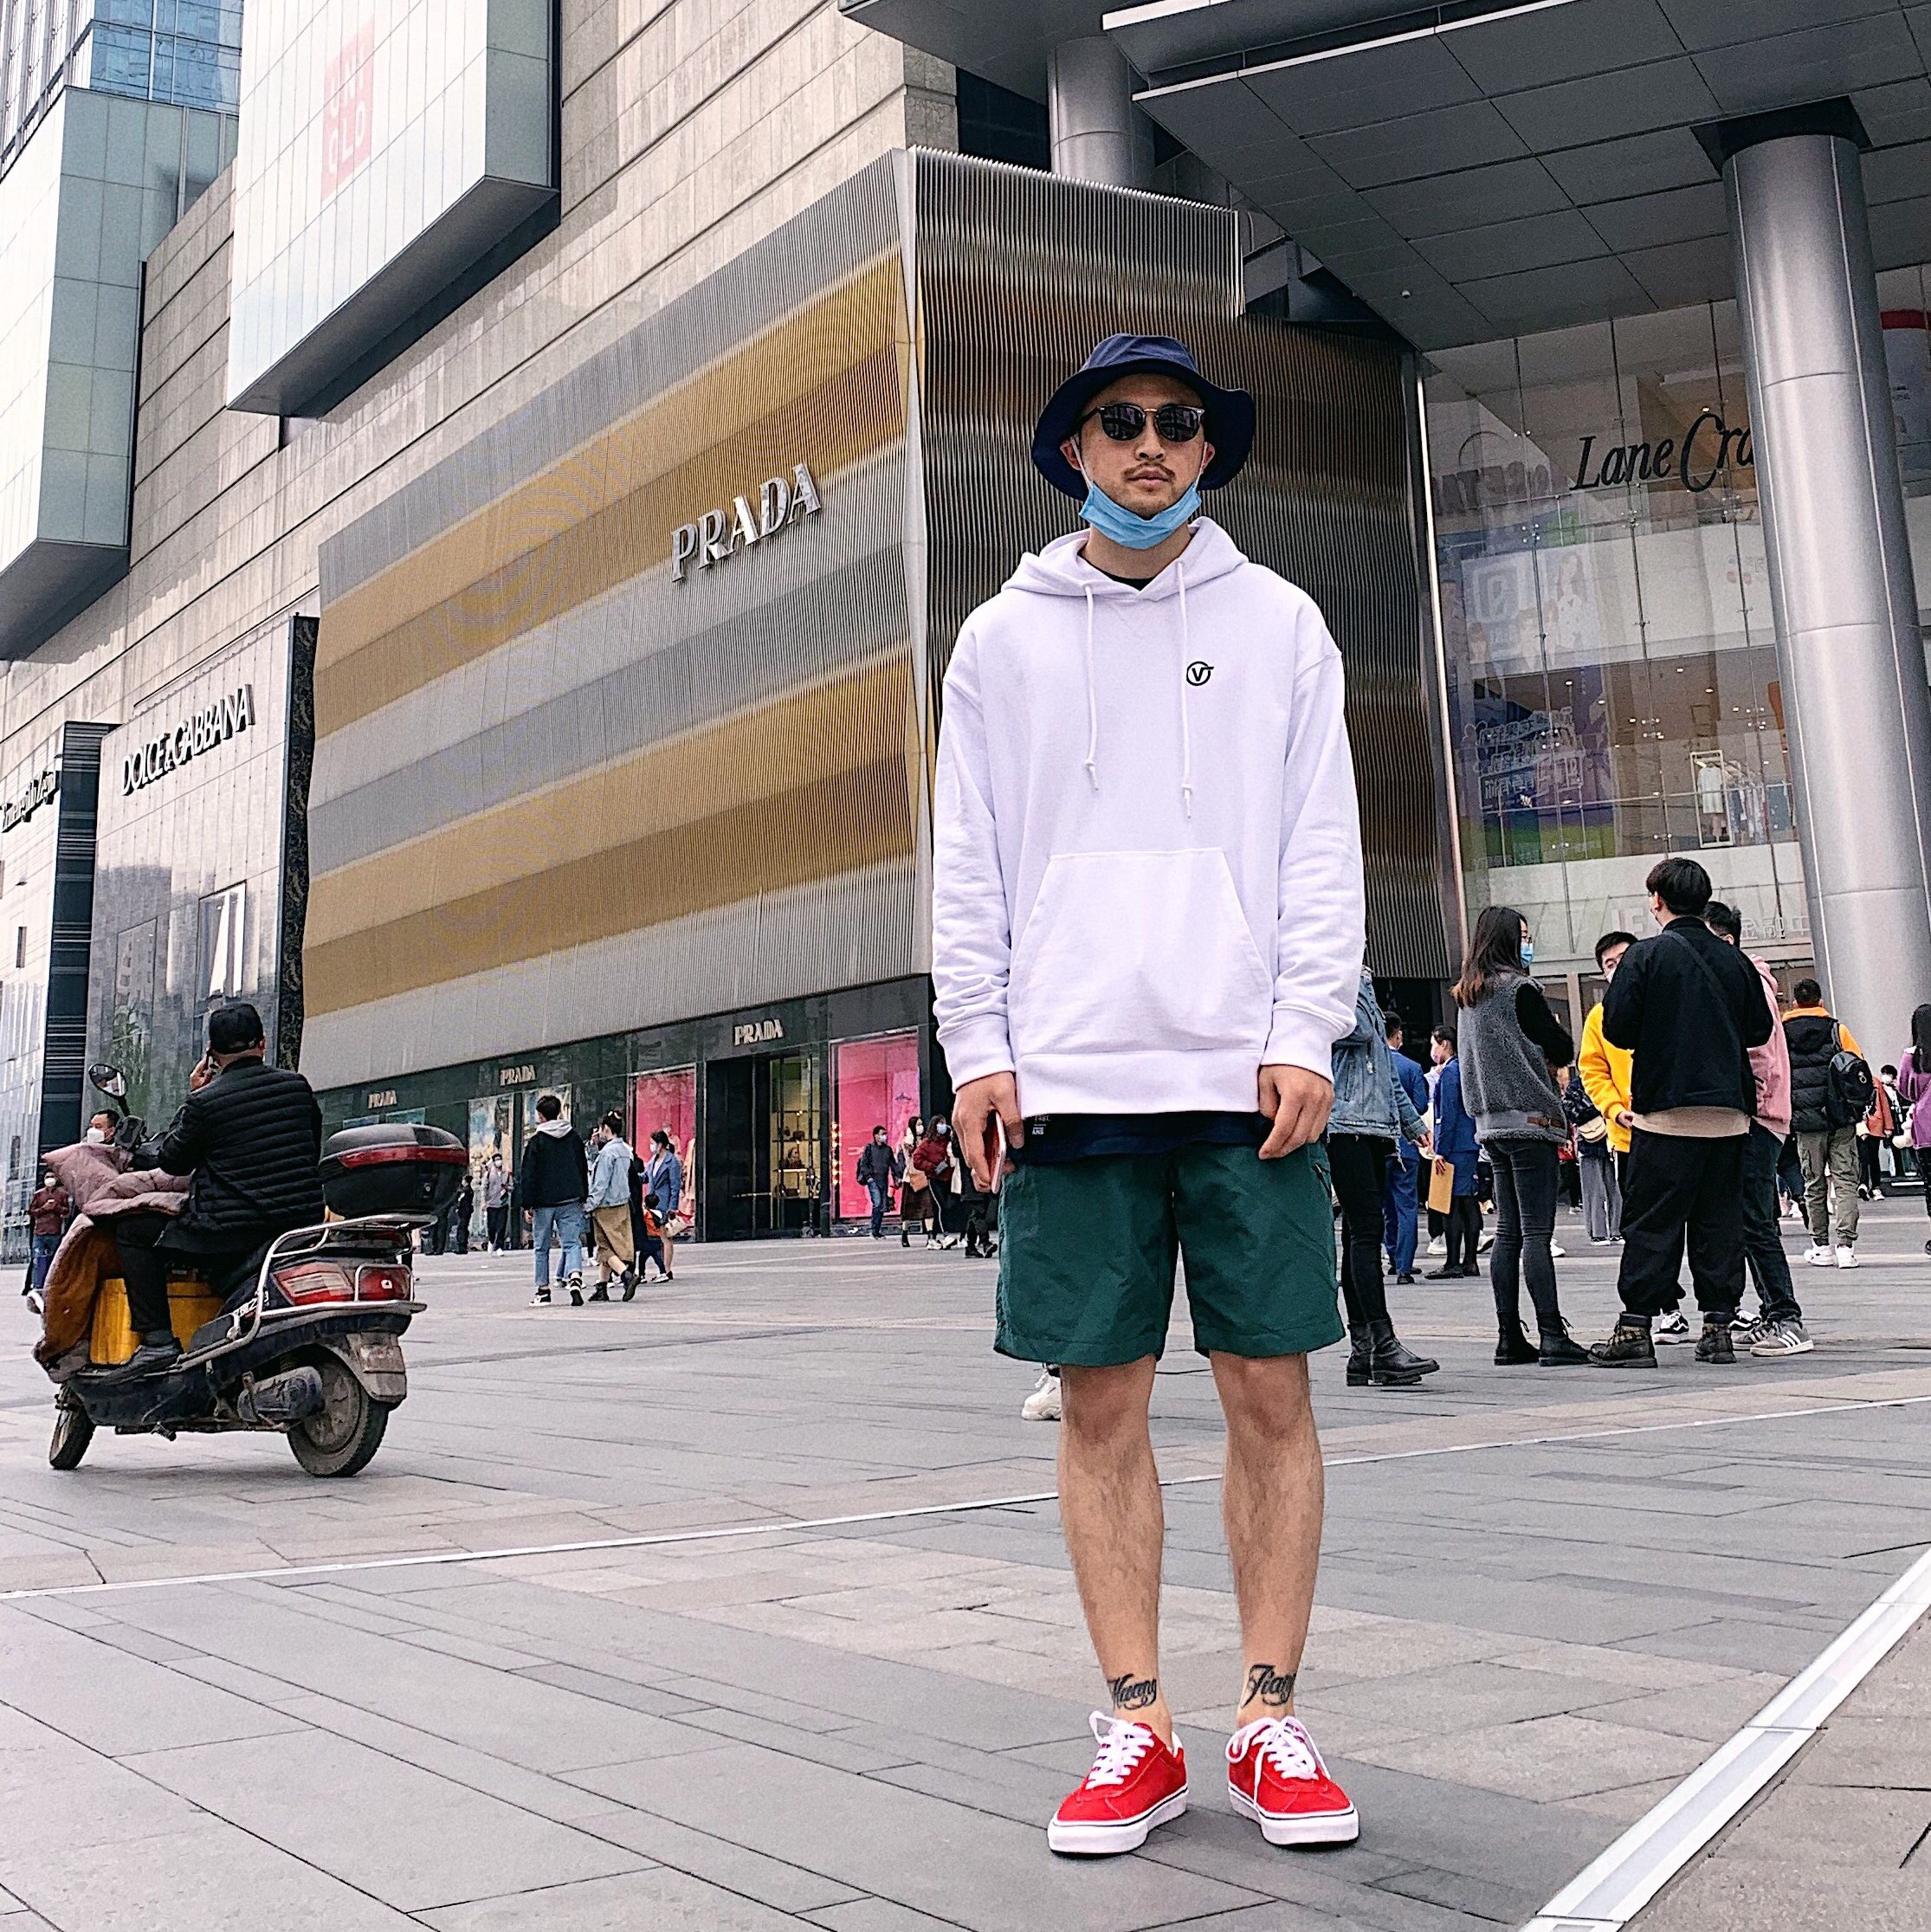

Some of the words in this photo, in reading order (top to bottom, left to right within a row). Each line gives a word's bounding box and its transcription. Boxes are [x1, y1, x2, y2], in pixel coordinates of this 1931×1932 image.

[1569, 435, 1674, 490] Lane
[671, 462, 822, 582] PRADA
[734, 1018, 784, 1045] PRADA
[500, 1065, 536, 1086] PRADA
[368, 1090, 397, 1109] PRADA
